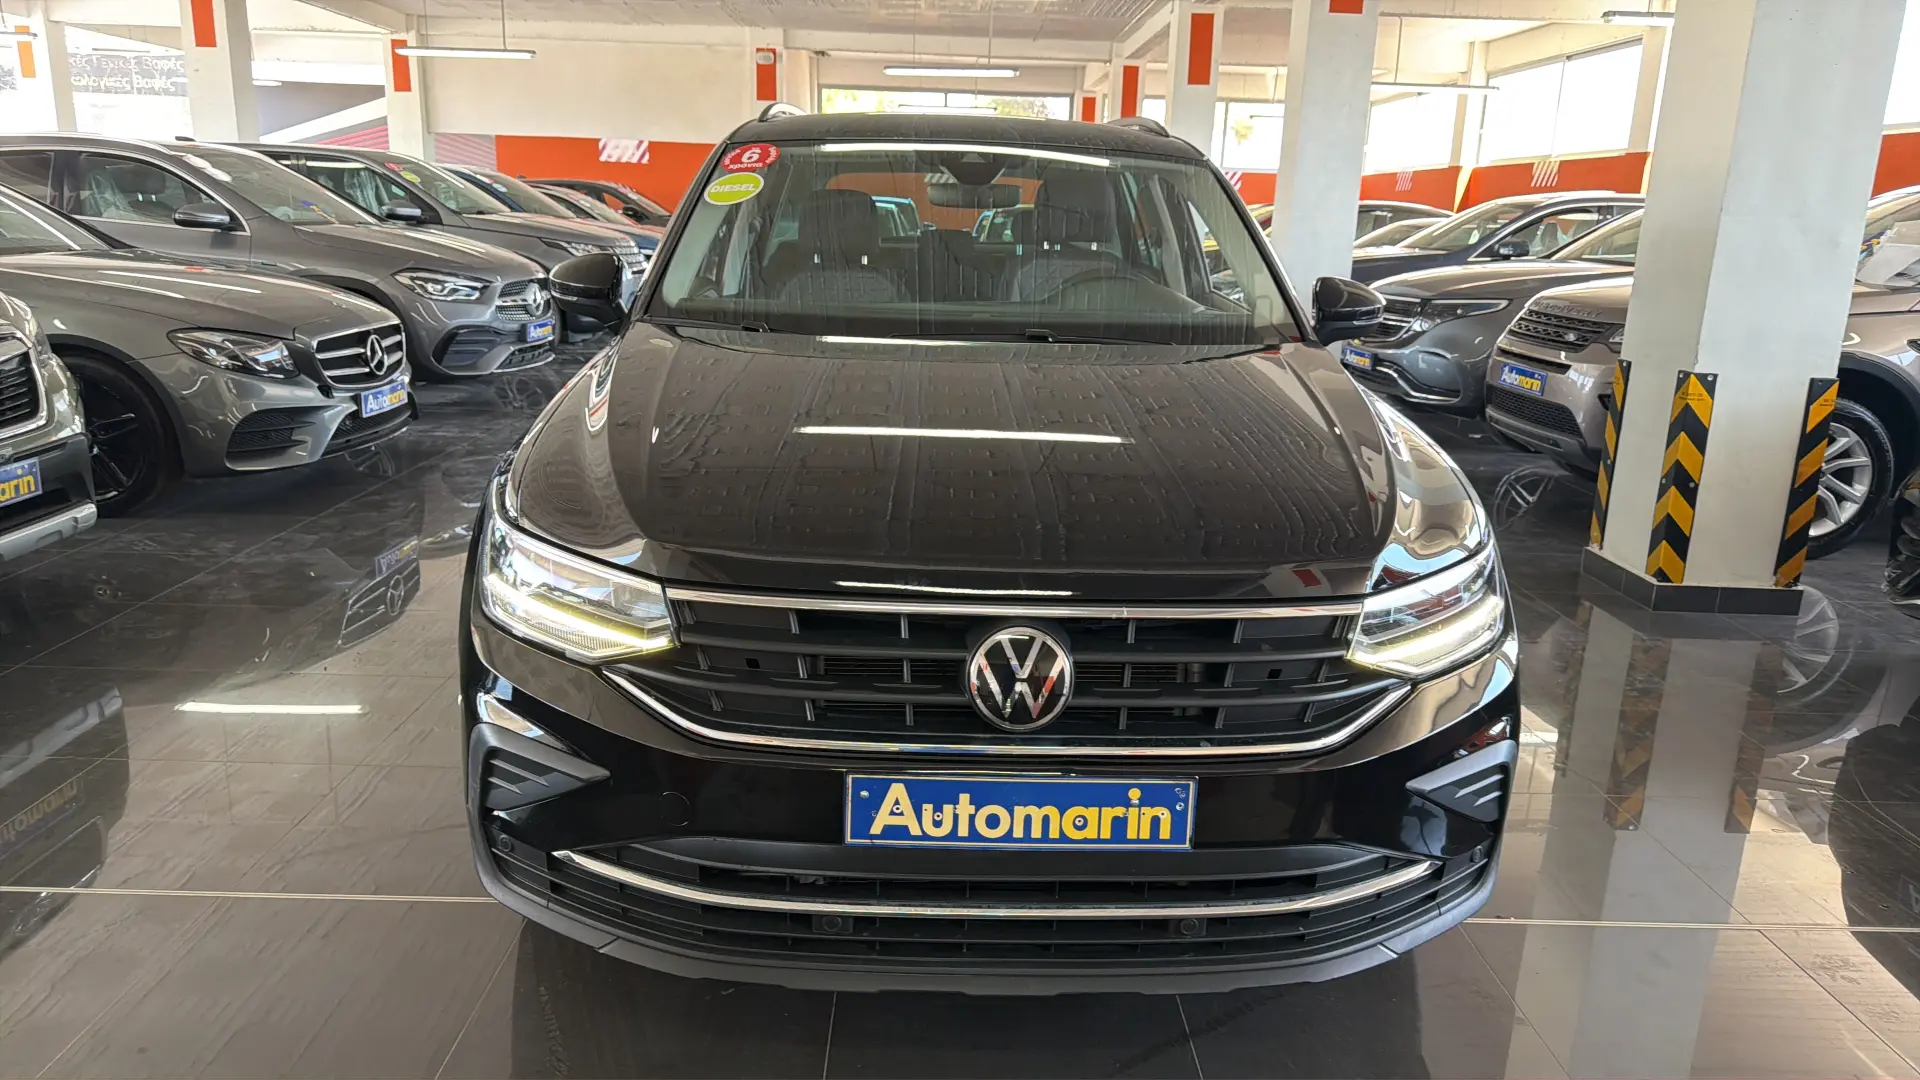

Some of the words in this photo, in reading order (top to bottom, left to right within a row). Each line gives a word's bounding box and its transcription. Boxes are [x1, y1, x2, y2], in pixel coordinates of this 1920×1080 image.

[142, 56, 185, 73] Βαφές
[132, 75, 176, 91] Βαφές
[710, 184, 757, 193] DIESEL
[1501, 366, 1542, 392] Automarin
[366, 385, 405, 413] Automarin
[870, 782, 1172, 841] Automarin
